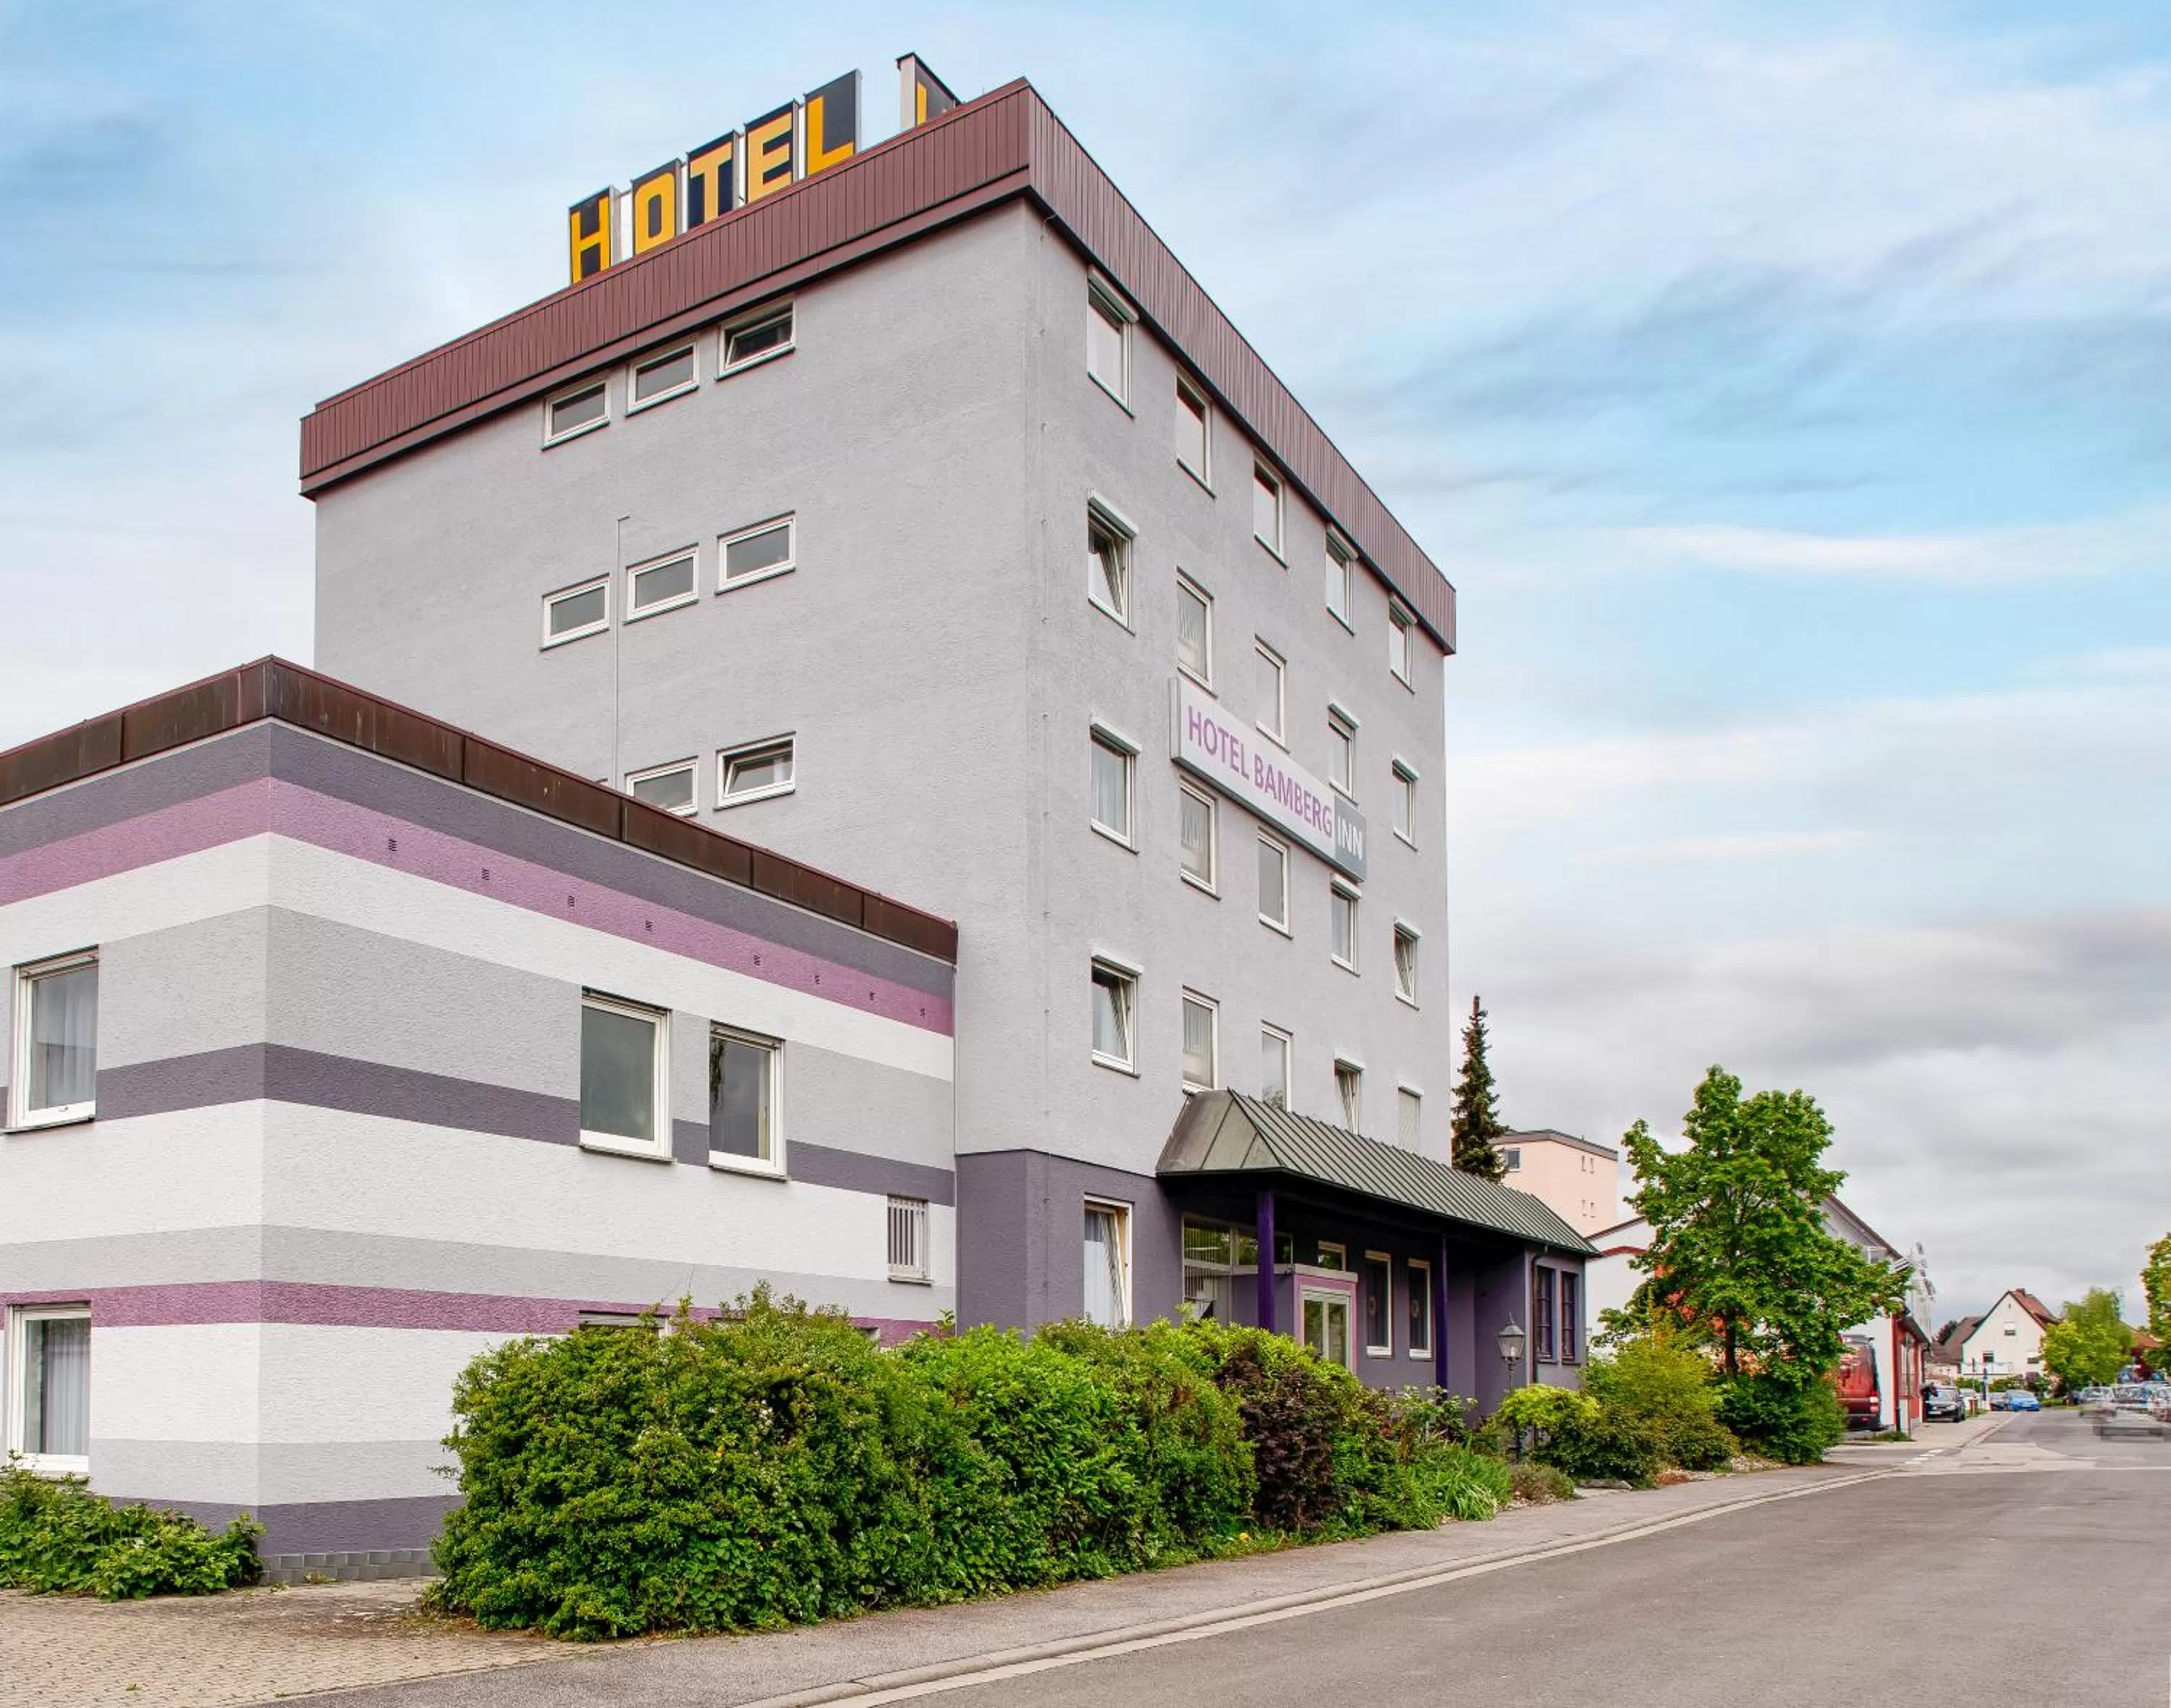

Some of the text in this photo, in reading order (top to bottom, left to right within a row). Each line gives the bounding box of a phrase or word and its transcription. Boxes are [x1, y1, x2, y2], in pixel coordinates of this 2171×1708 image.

[570, 96, 855, 284] HOTEL
[1188, 706, 1363, 861] HOTEL BAMBERG INN
